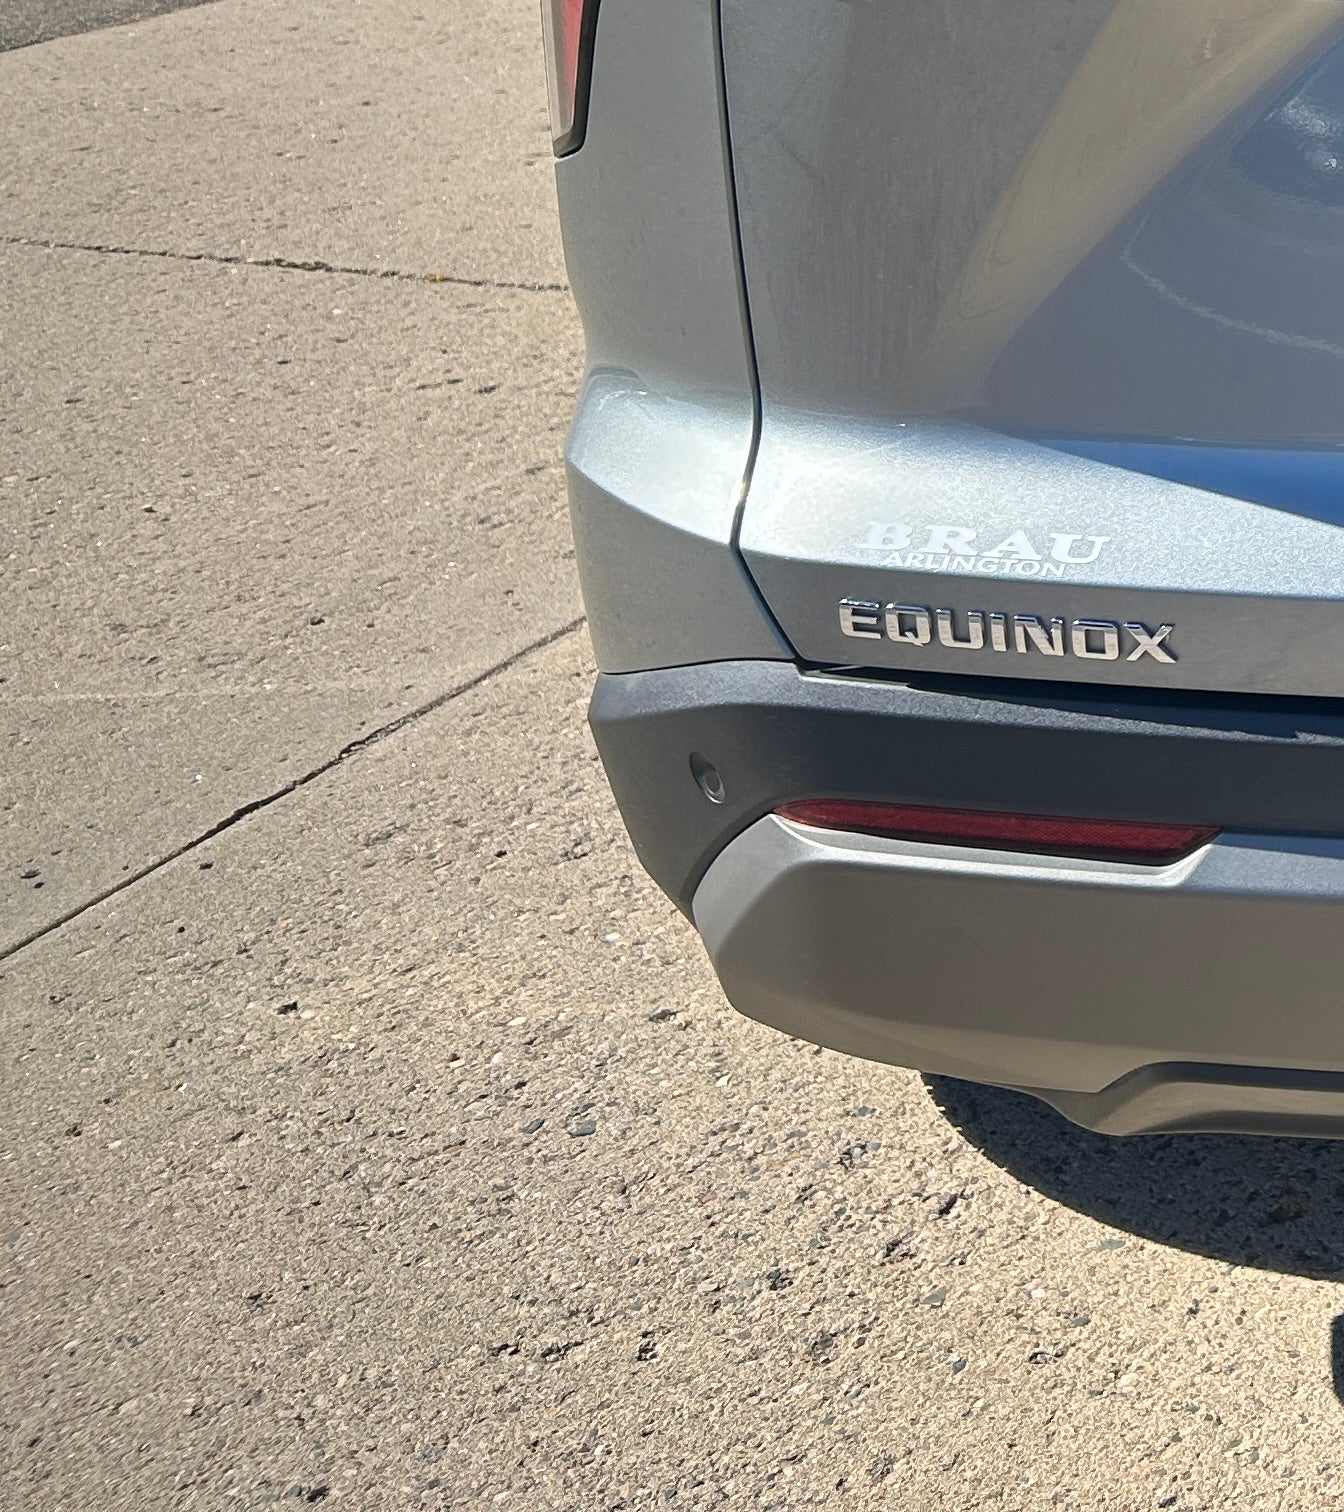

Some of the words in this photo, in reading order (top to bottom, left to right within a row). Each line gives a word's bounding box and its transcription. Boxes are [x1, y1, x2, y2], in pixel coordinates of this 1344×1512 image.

[858, 521, 1110, 564] BRAU
[882, 551, 1068, 578] ARLINGTON
[838, 599, 1178, 665] EQUINOX
